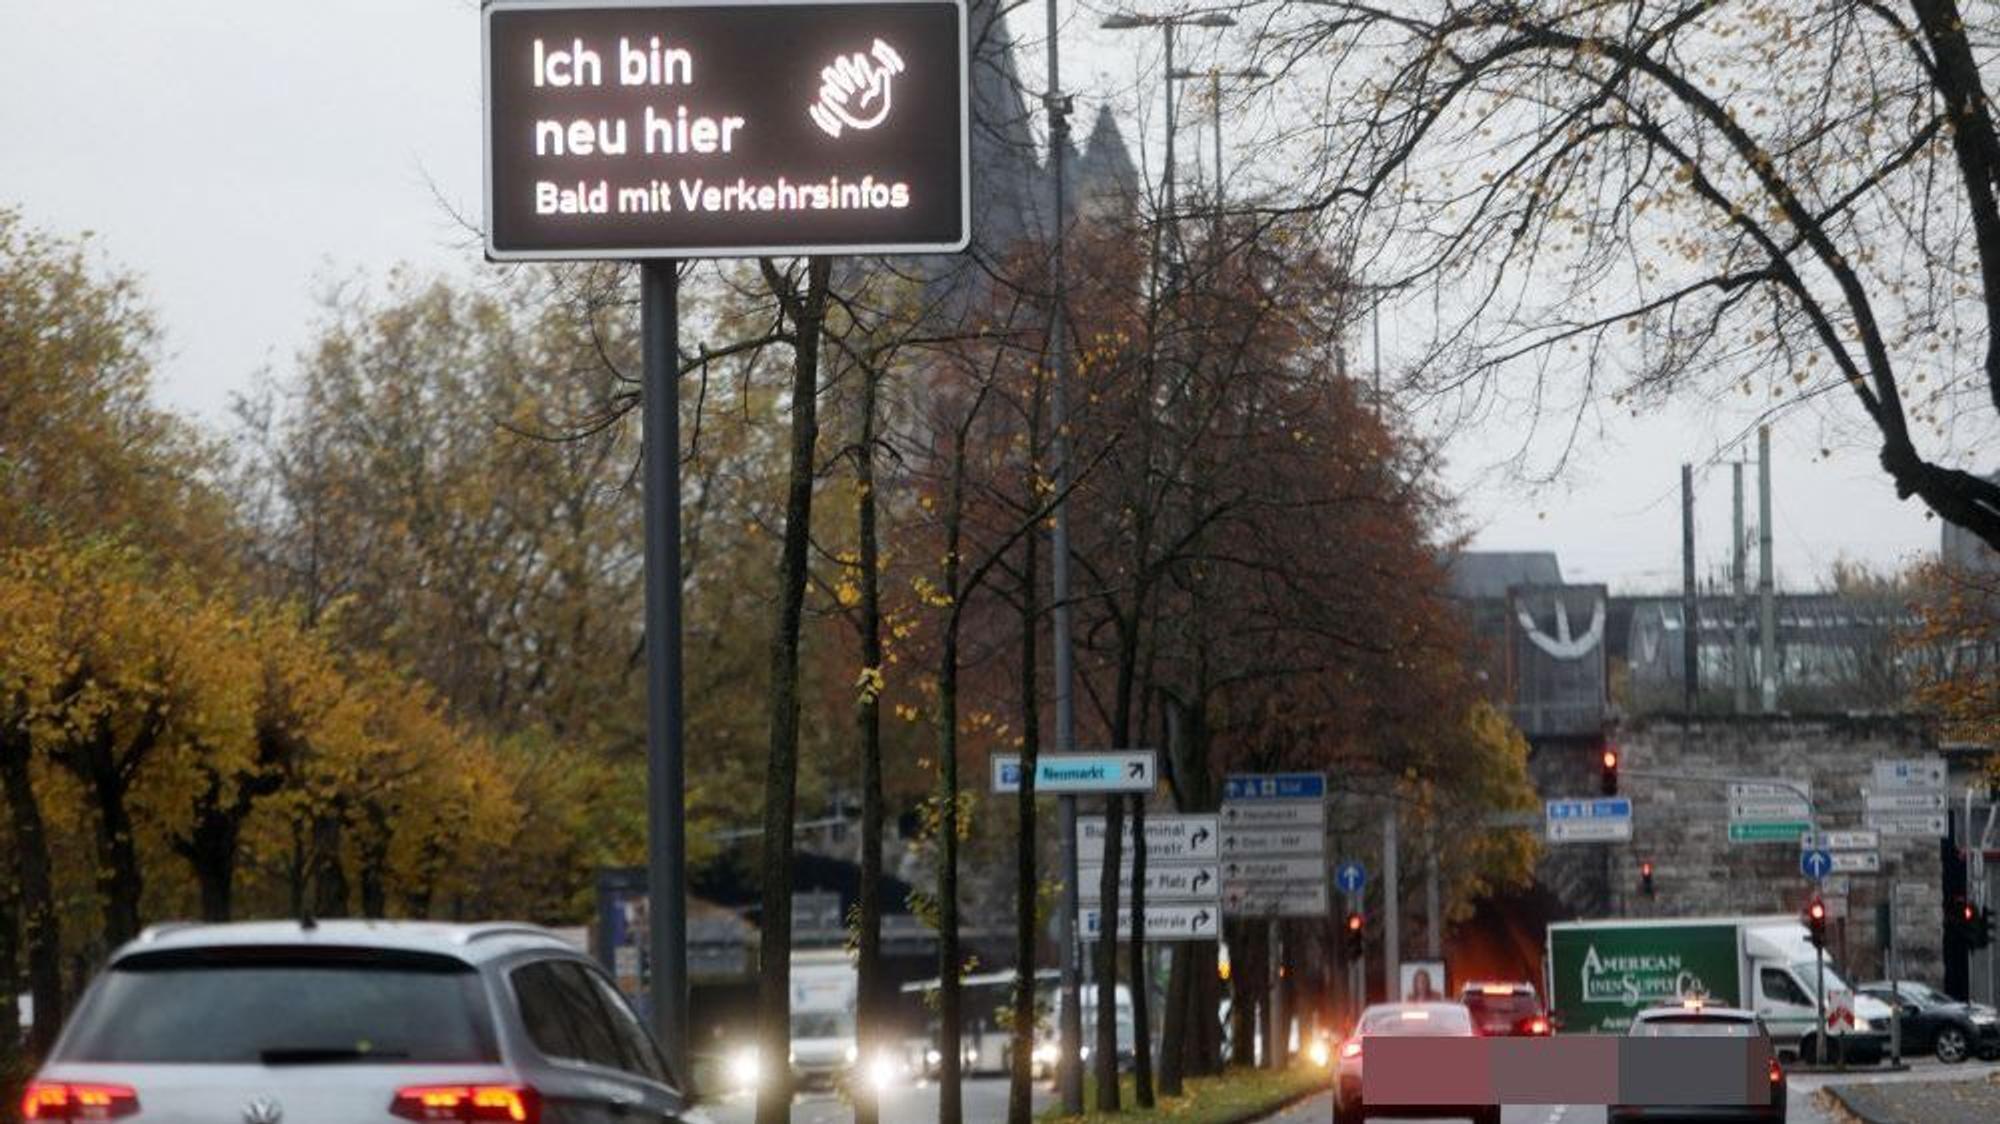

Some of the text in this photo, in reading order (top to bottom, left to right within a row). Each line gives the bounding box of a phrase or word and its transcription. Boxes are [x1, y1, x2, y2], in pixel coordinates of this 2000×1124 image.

[533, 37, 692, 88] Ich bin
[535, 106, 745, 156] neu hier
[535, 175, 910, 215] Bald mit Verkehrsinfos
[1043, 763, 1104, 781] Neumarkt
